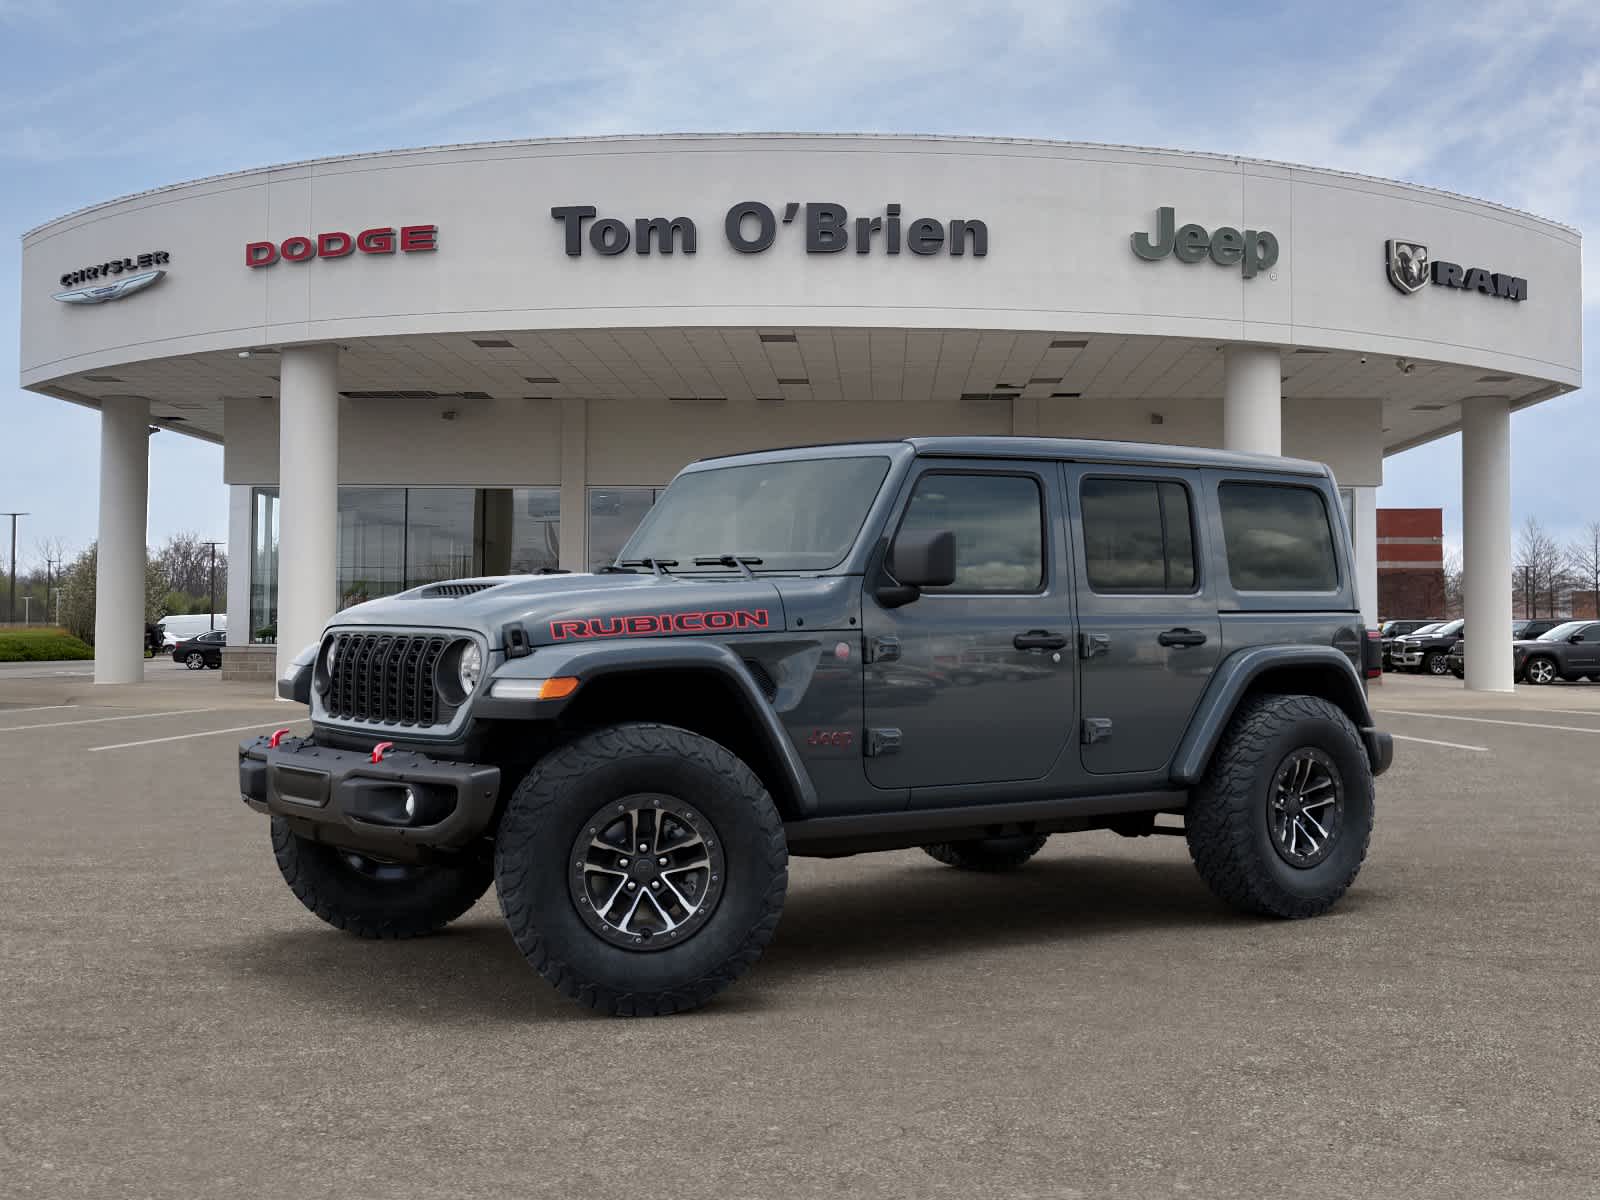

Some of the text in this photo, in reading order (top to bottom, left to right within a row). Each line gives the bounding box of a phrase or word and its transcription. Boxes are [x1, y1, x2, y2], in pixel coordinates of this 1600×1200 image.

[246, 224, 438, 268] DODGE
[551, 201, 989, 257] Tom O'Brien
[1130, 206, 1279, 279] Jeep
[60, 250, 170, 286] CHRYSLER
[1431, 260, 1528, 302] RAM
[550, 609, 769, 640] RUBICON
